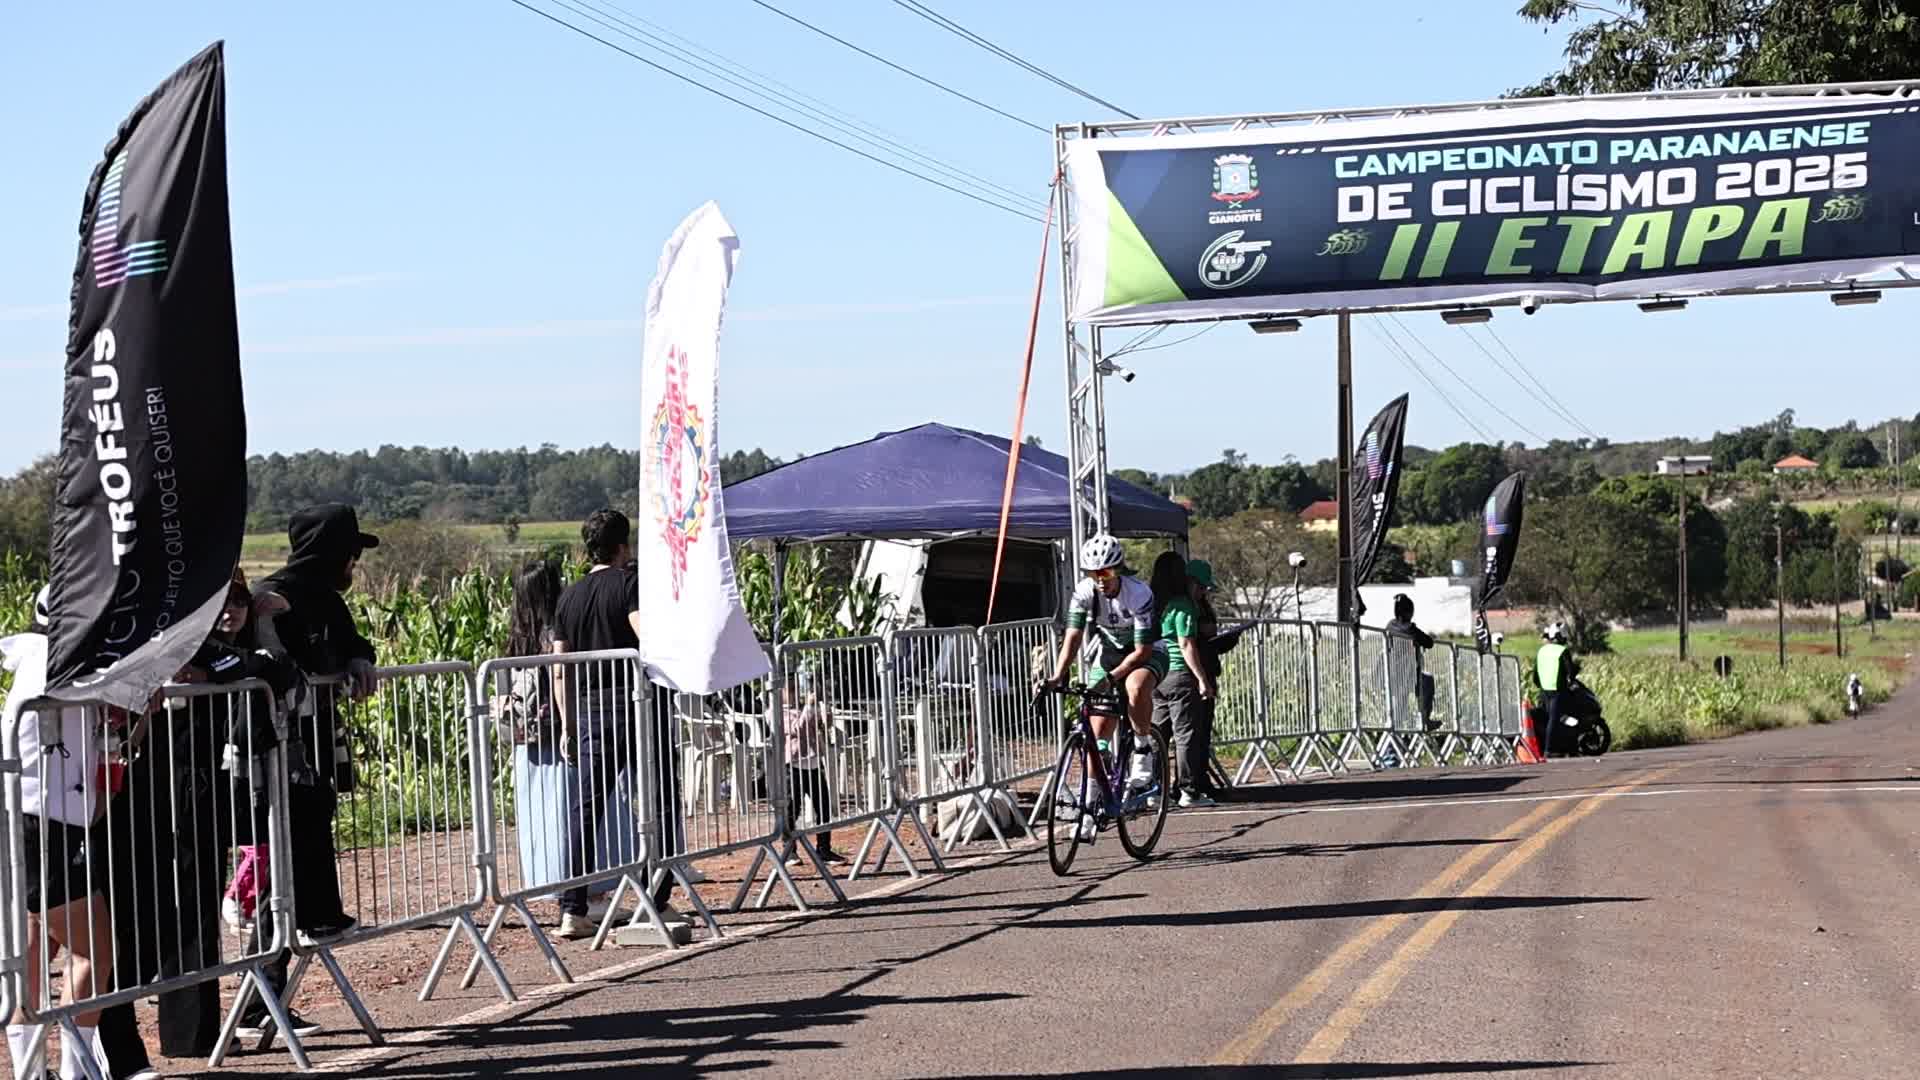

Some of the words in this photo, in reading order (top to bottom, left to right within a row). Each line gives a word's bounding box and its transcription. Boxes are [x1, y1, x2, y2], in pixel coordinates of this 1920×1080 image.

[1335, 140, 1598, 178] CAMPEONATO
[1610, 121, 1871, 165] PARANAENSE
[1208, 212, 1263, 224] CIANORTE
[1337, 182, 1413, 223] DE
[1431, 163, 1697, 216] CICLÍSMO
[1378, 221, 1461, 280] II
[1484, 197, 1811, 276] ETAPA
[88, 328, 138, 566] TROFÉUS
[145, 384, 173, 465] QUISER!
[153, 468, 179, 518] VOCÊ
[163, 519, 186, 556] QUE
[162, 558, 186, 608] JEITO
